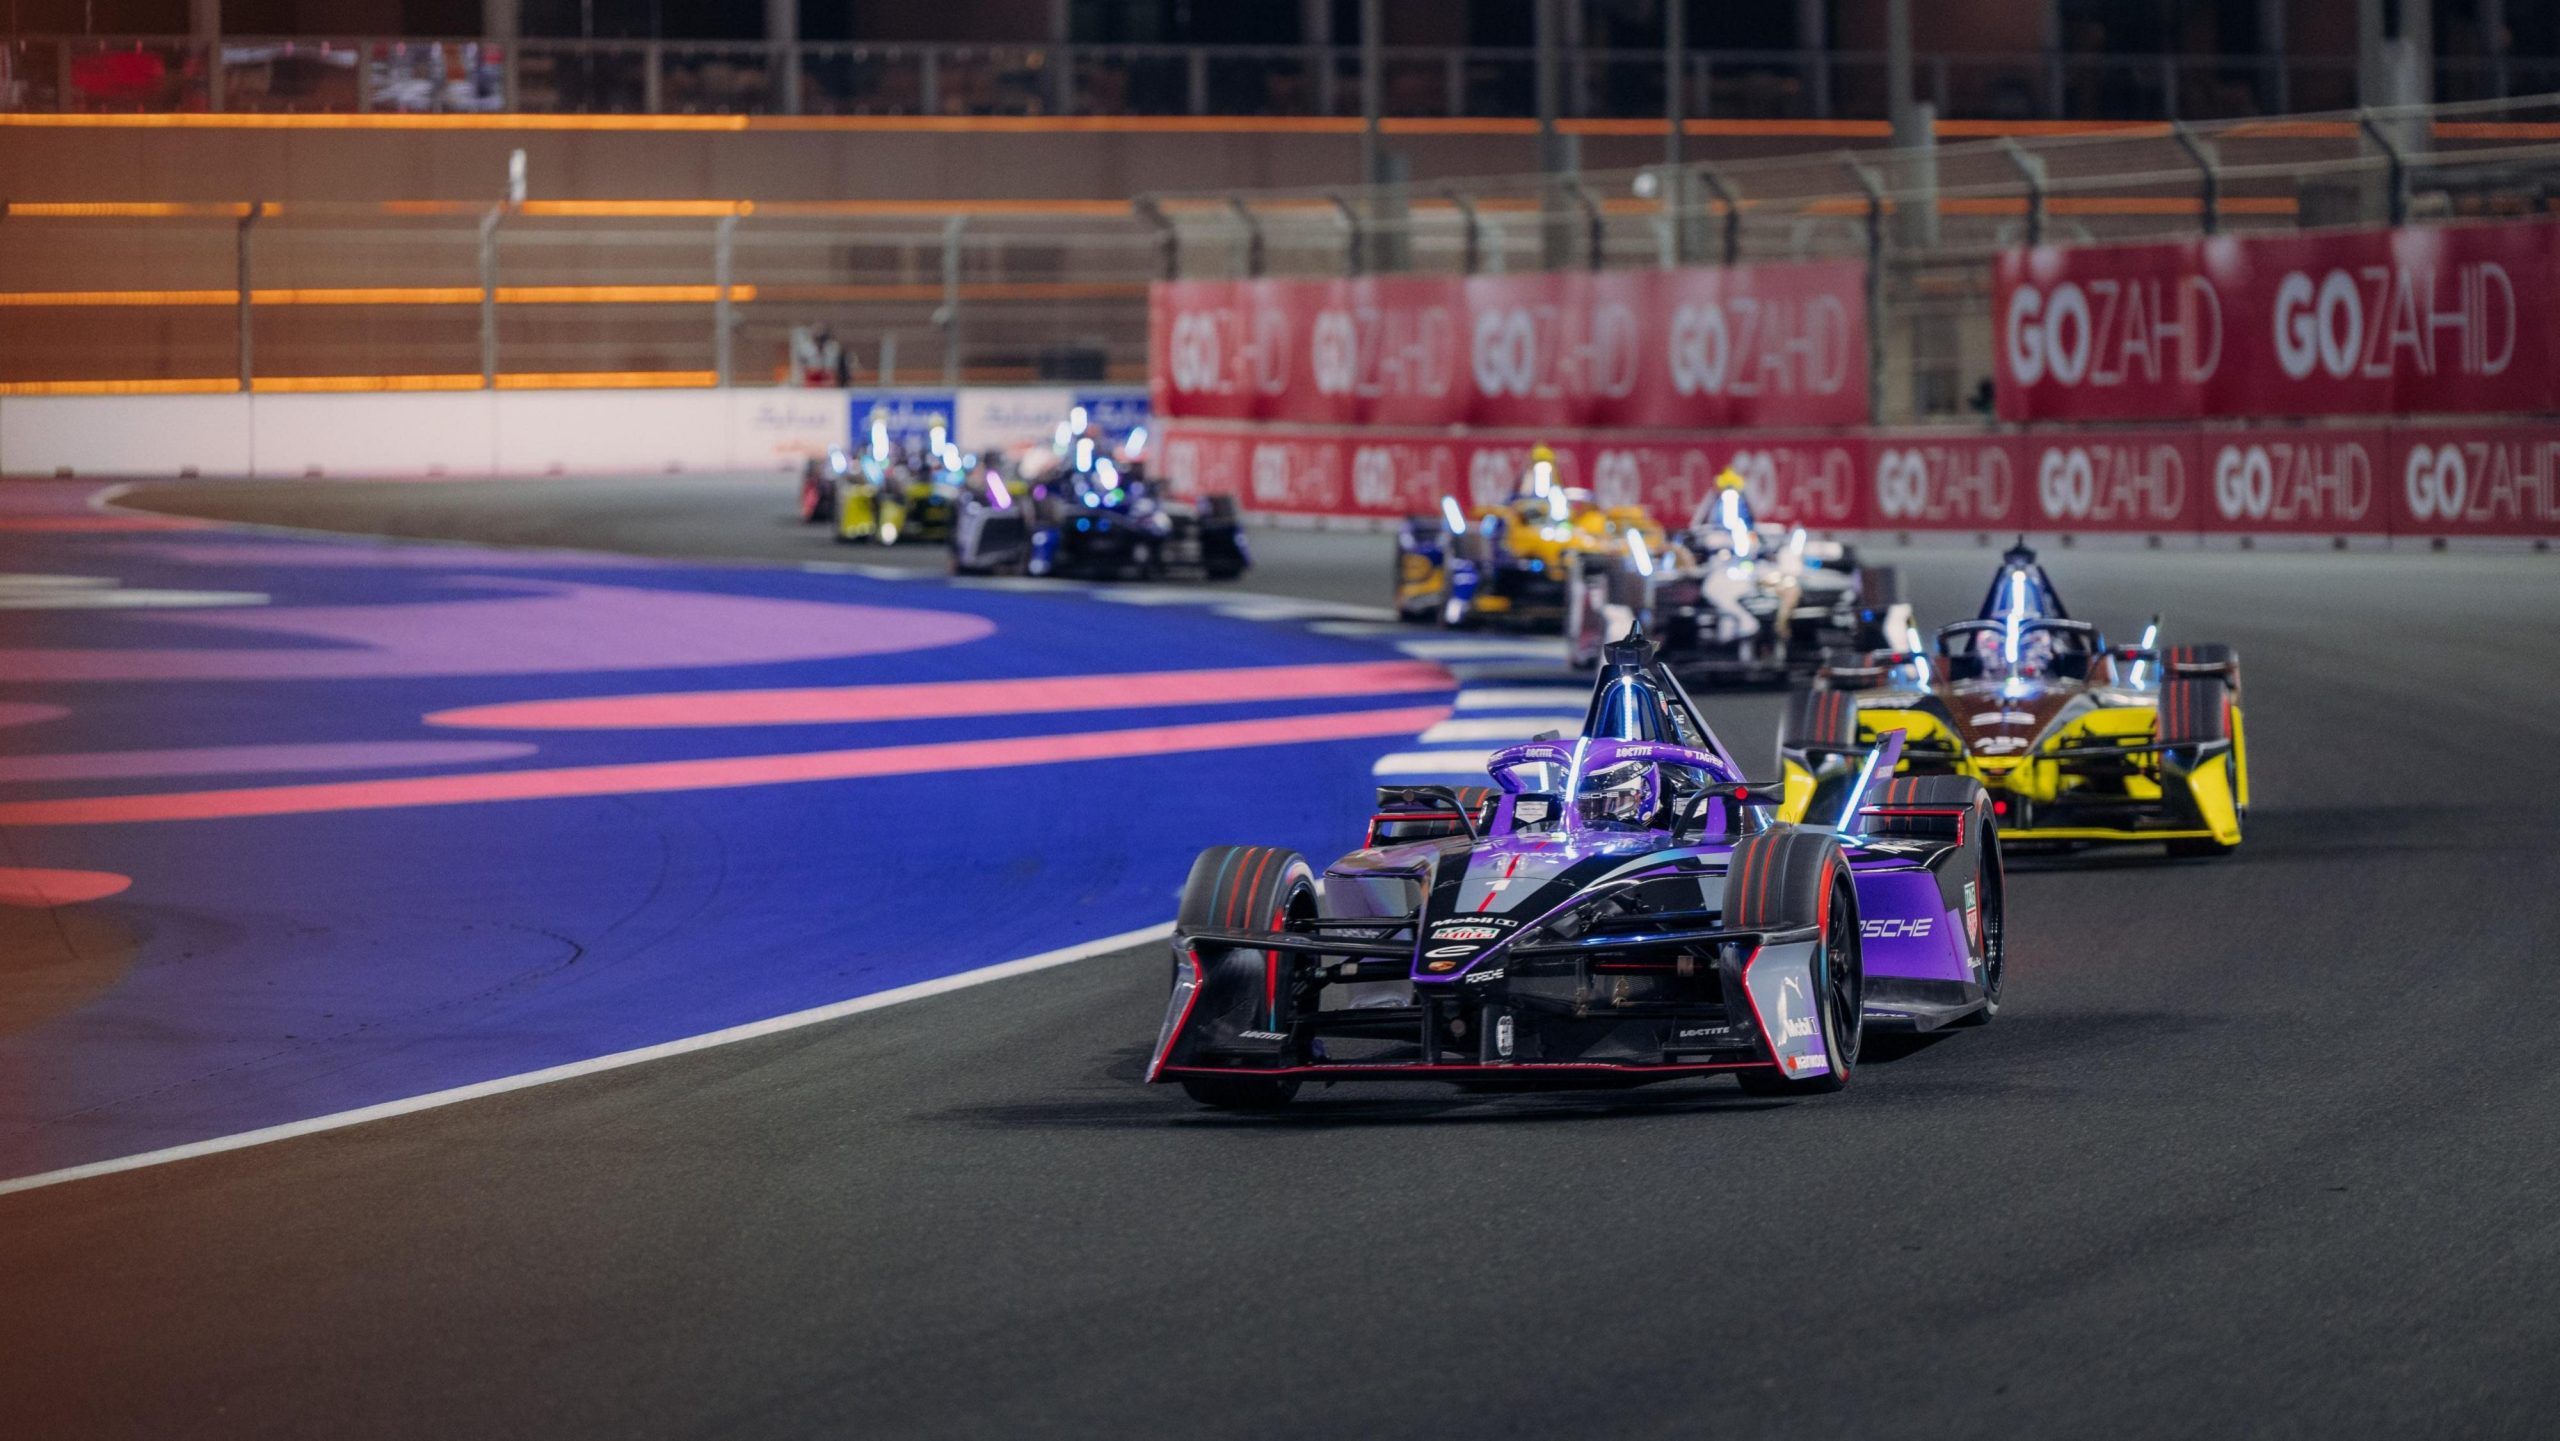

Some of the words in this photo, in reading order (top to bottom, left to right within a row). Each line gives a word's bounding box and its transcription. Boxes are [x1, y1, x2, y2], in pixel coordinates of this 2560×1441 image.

[2273, 262, 2516, 380] GOZAHID
[1615, 747, 1653, 758] LOCTITE
[1430, 916, 1494, 928] Mobil
[1465, 968, 1505, 984] PORSCHE
[1679, 1026, 1730, 1038] LOCTITE
